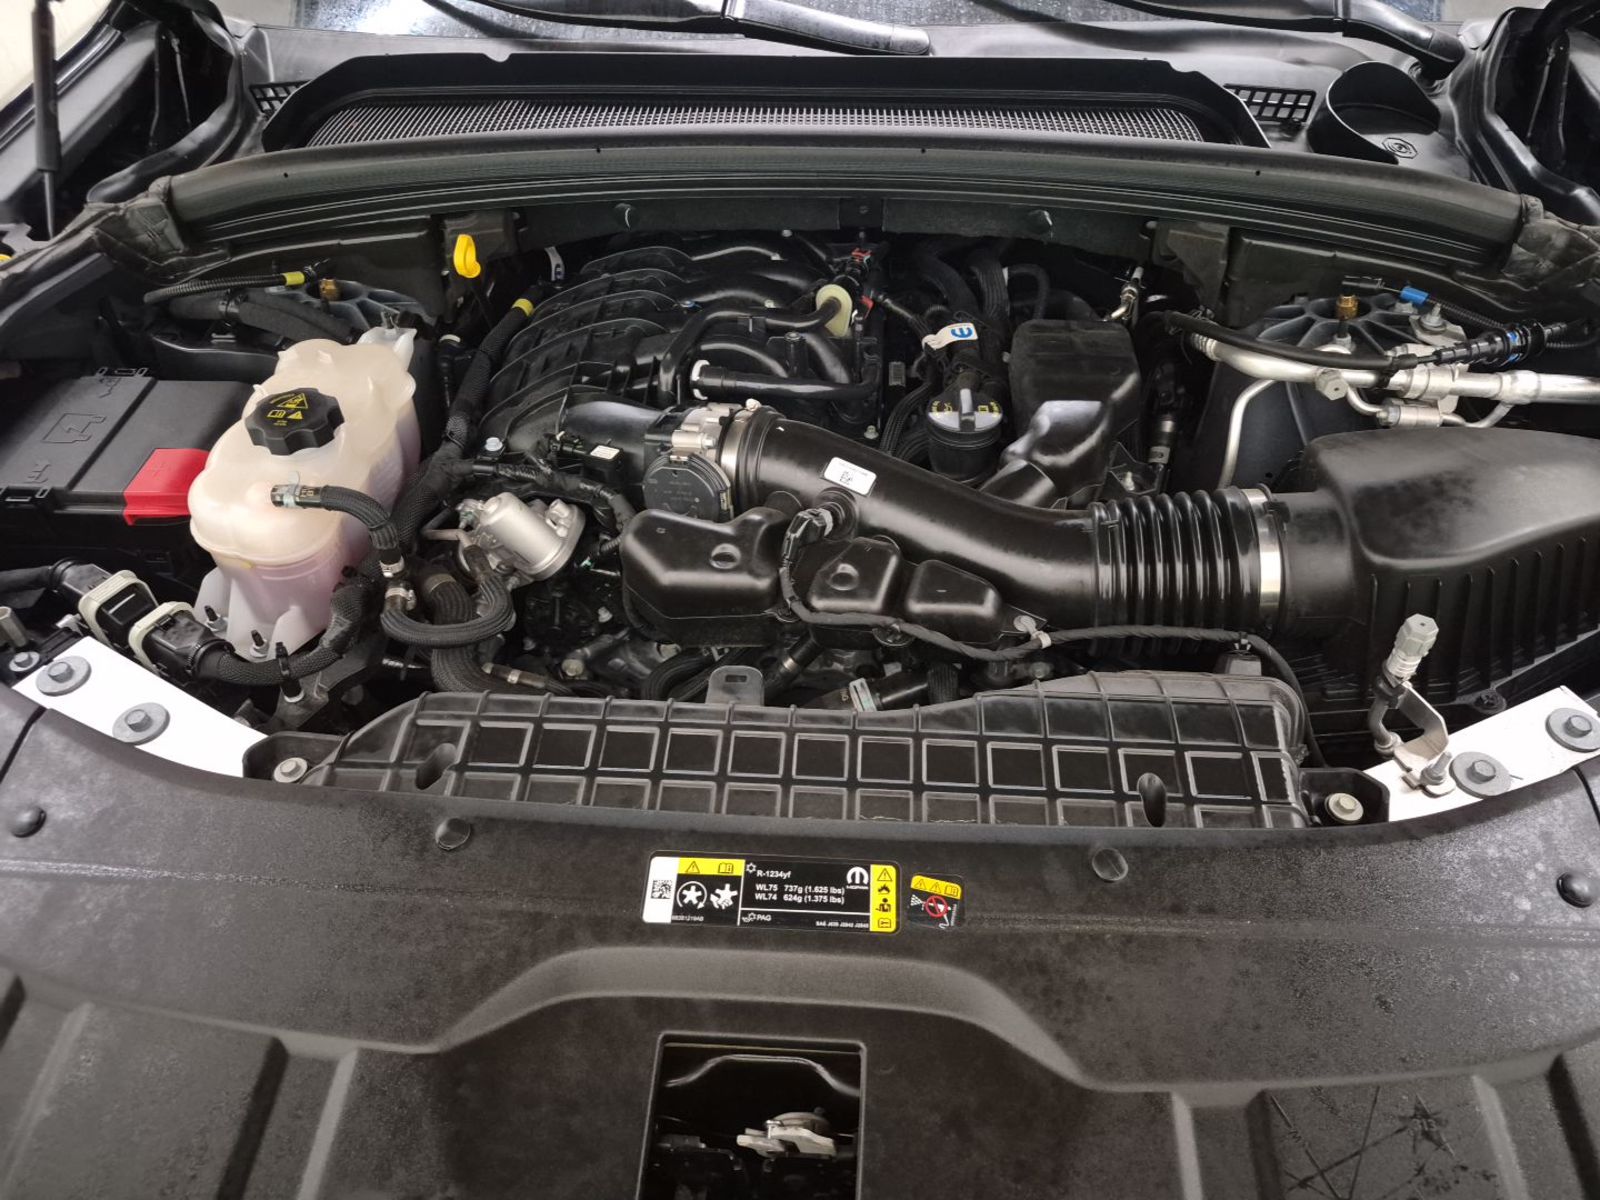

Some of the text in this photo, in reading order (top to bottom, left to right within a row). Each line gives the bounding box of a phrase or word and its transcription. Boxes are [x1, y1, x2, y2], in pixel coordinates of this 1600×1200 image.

[756, 869, 792, 880] R-1234yf
[755, 883, 846, 896] WL75 737g (1.625 lbs)
[754, 892, 845, 906] WL74 624g (1.375 lbs)
